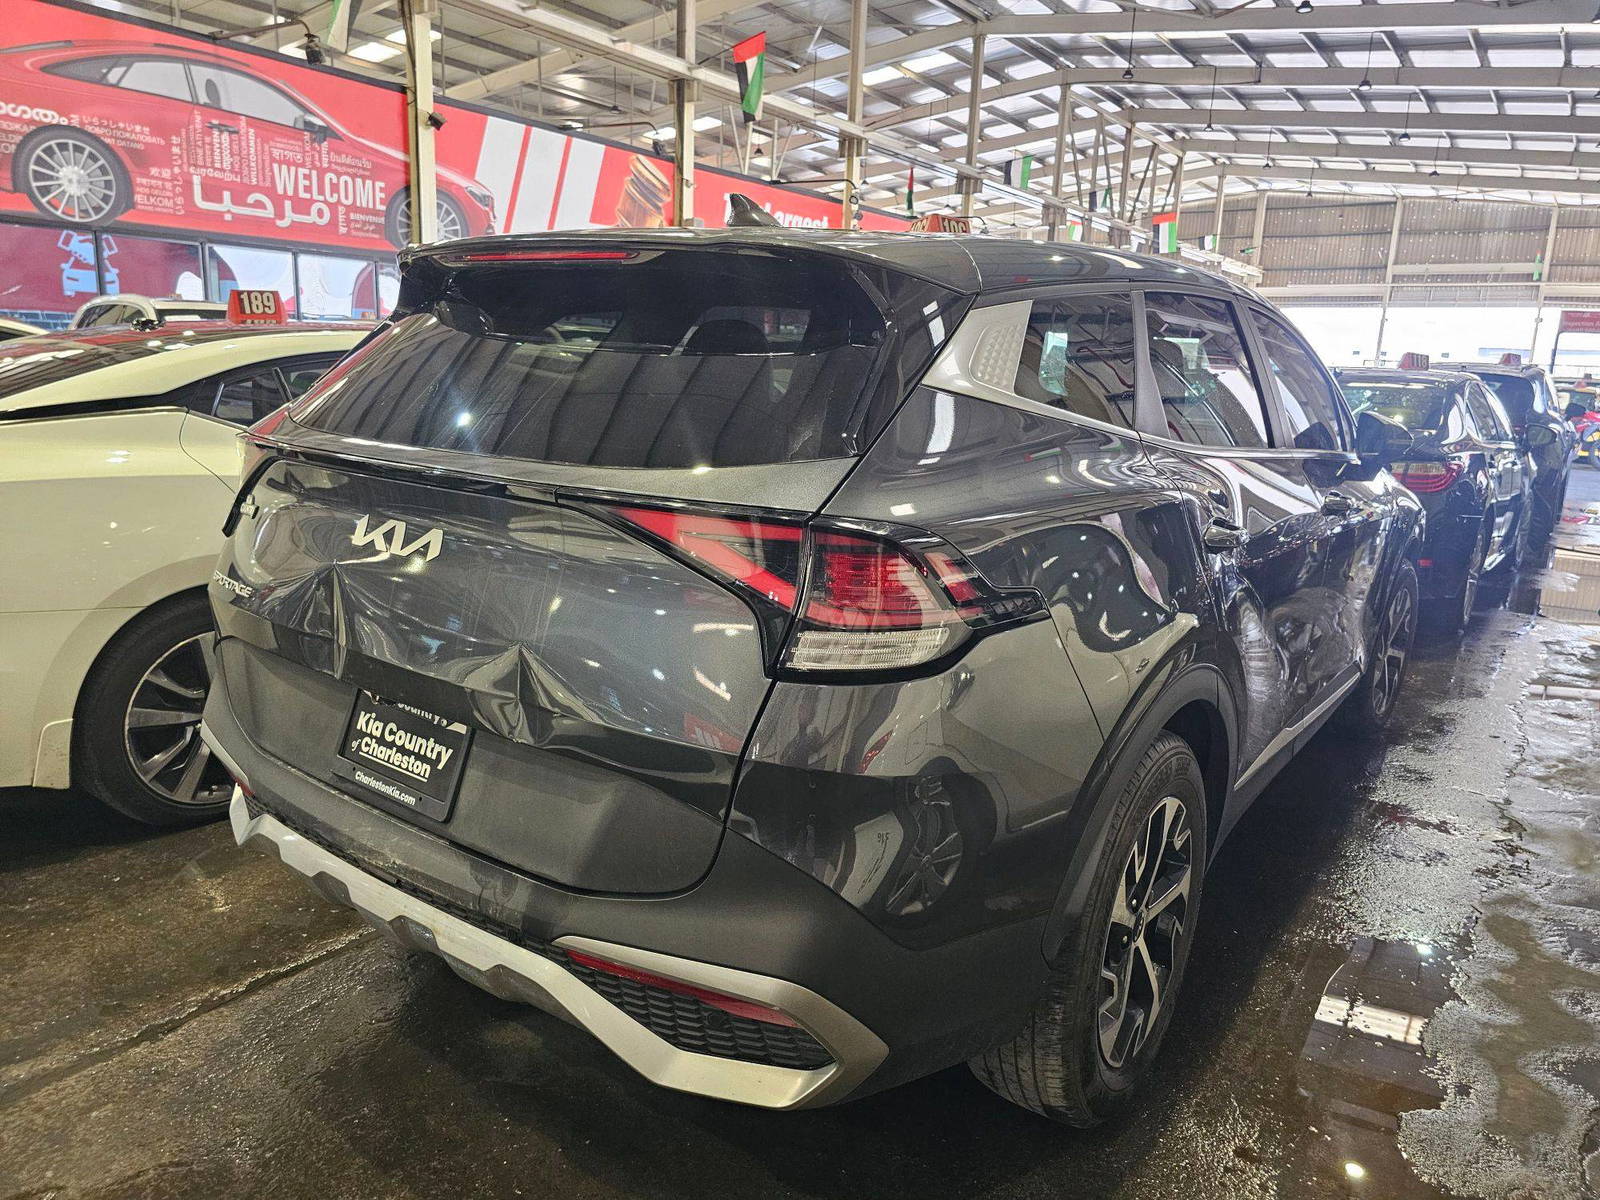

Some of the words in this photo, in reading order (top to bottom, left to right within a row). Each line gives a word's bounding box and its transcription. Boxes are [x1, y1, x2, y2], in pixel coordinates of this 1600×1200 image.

[248, 128, 258, 185] WILLKOMMEN
[192, 174, 331, 228] مرحبا
[272, 162, 386, 211] WELCOME
[240, 291, 276, 314] 189
[351, 513, 444, 562] KIA
[351, 738, 362, 752] of
[361, 736, 431, 779] Charleston
[356, 710, 384, 738] Kia
[384, 721, 454, 770] Country
[354, 770, 416, 806] CharlestonKia.com
